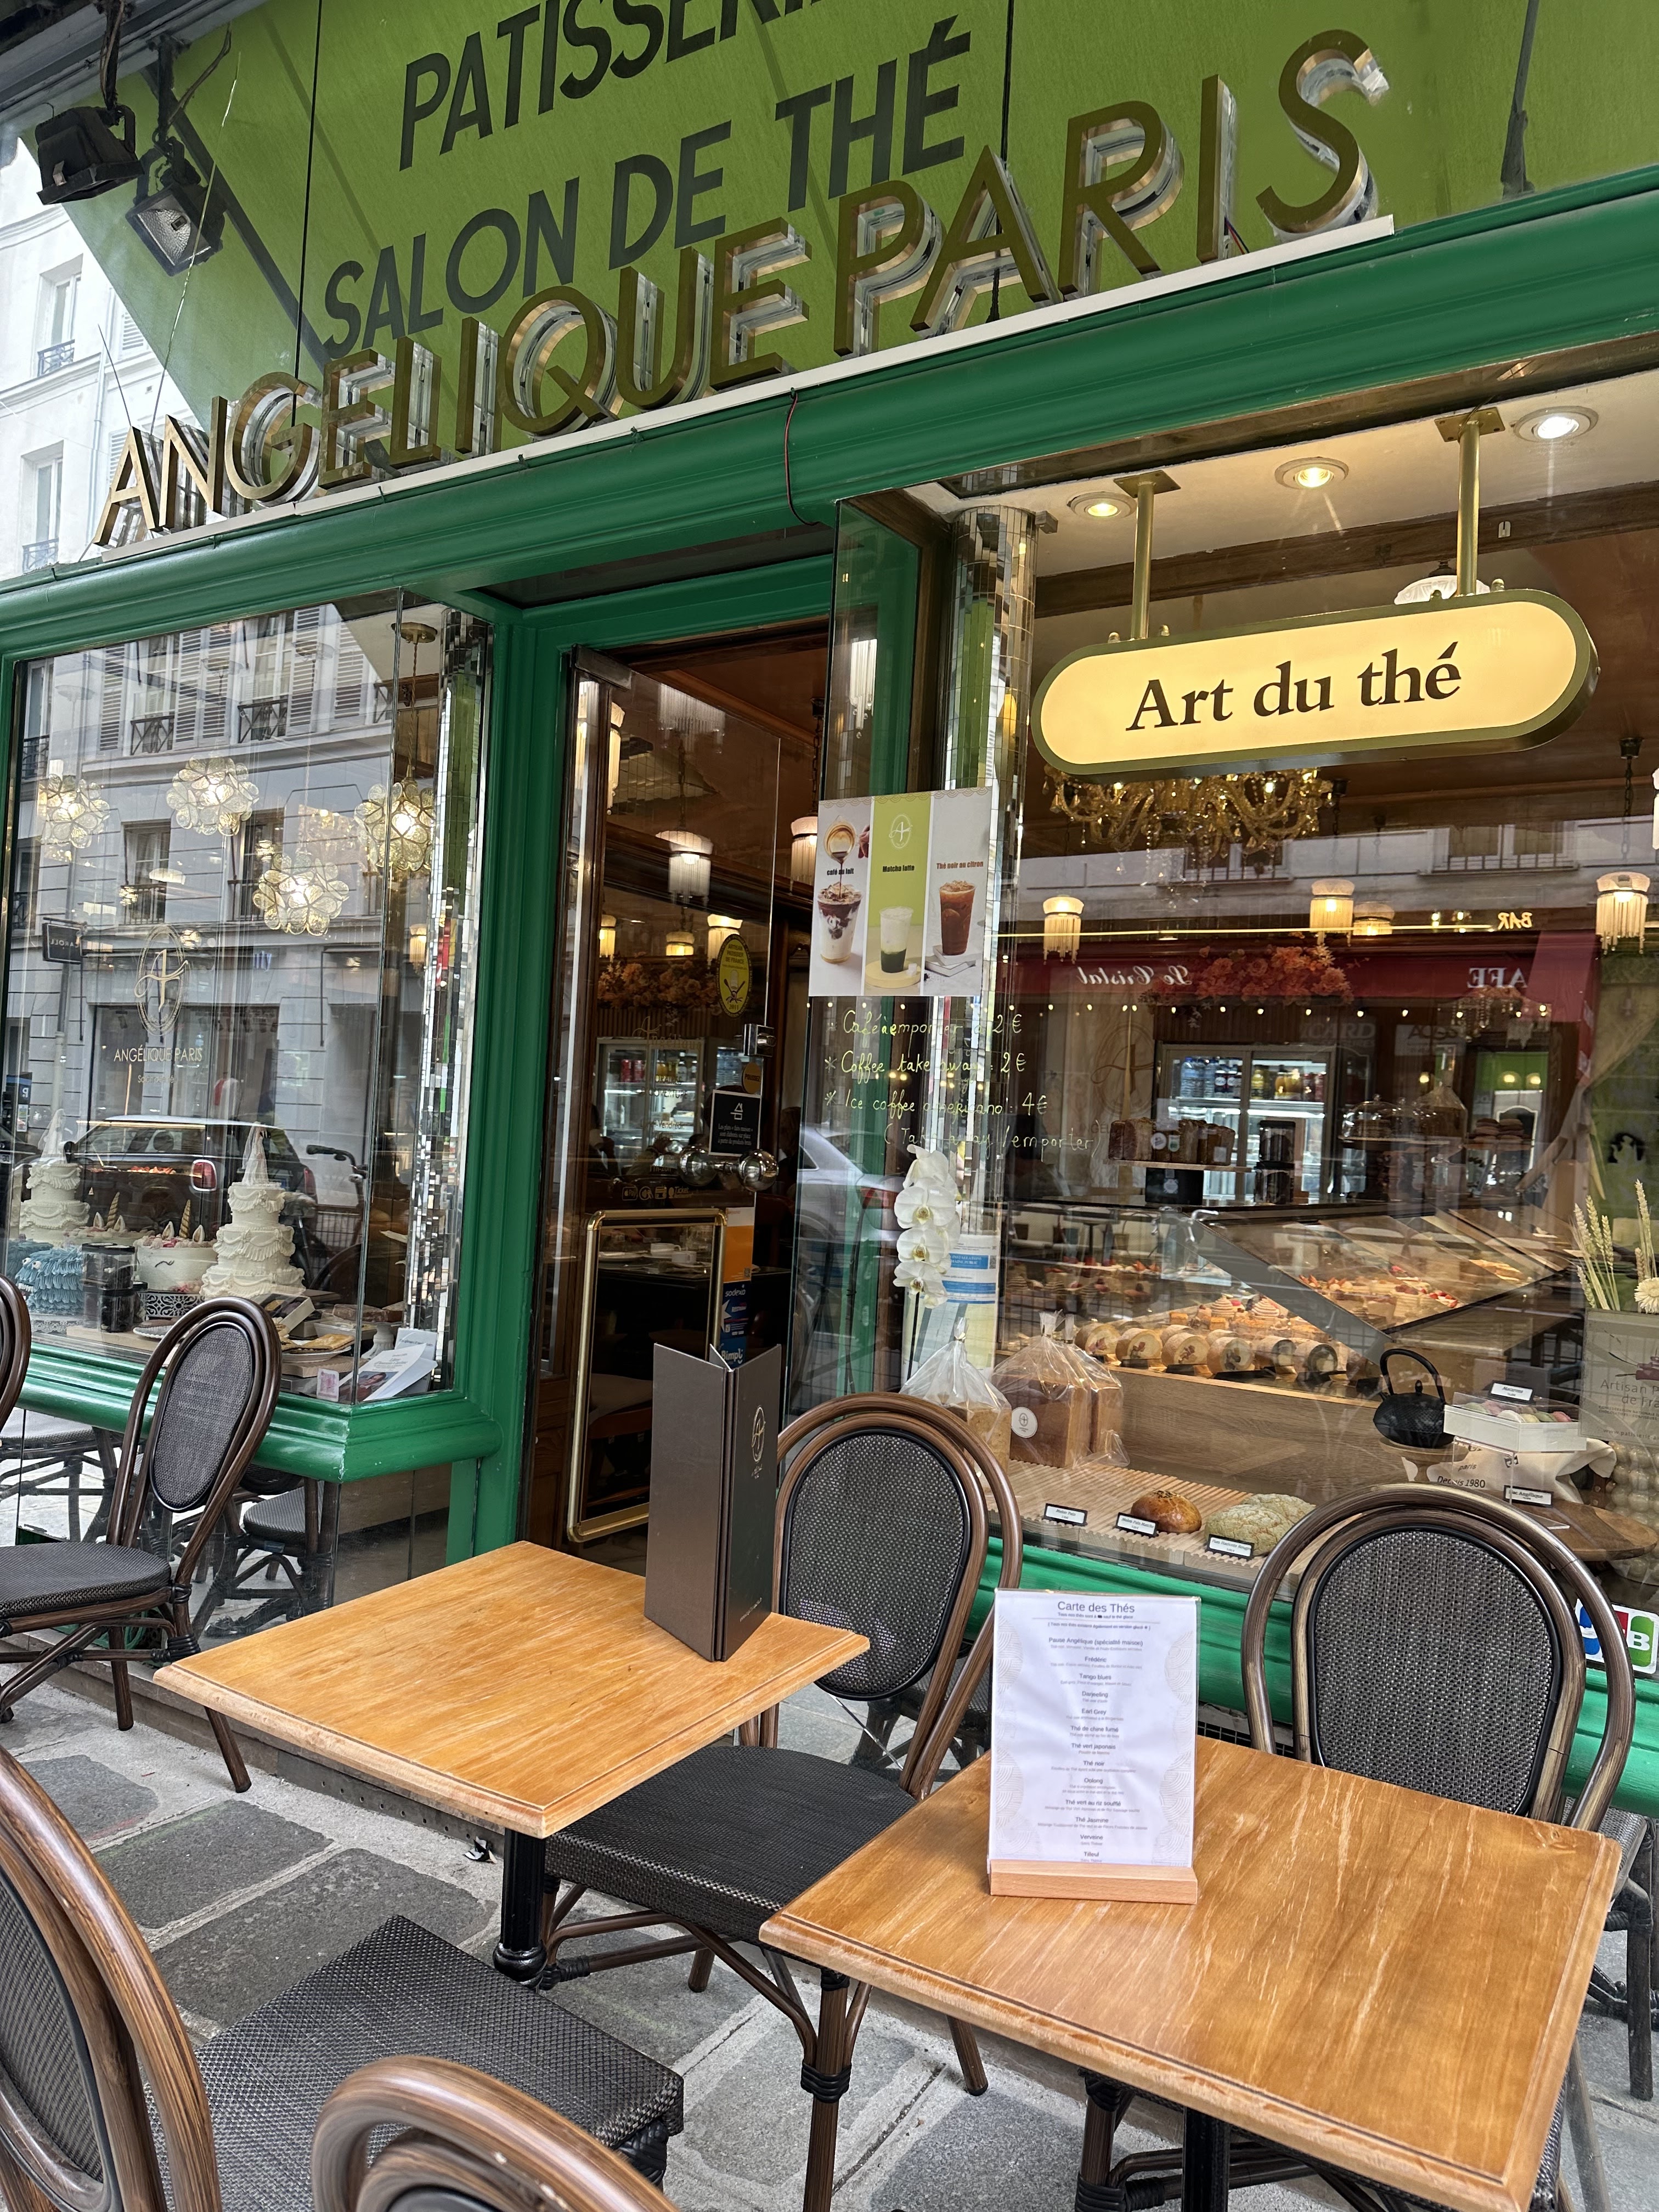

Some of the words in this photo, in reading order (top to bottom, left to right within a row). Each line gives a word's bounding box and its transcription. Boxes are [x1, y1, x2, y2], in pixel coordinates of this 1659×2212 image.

[324, 178, 579, 359] SALON
[608, 121, 731, 270] DE
[775, 15, 972, 212] THÉ
[94, 219, 812, 546] ANGELIQUE
[833, 29, 1388, 359] PARIS
[1125, 679, 1233, 731] Art
[1253, 660, 1334, 715] du
[1358, 641, 1462, 707] thé
[114, 1045, 172, 1062] ANGÉLIQUE
[174, 1047, 203, 1062] PARIS
[841, 1050, 884, 1084] Coffee
[897, 1053, 930, 1073] take
[845, 1088, 863, 1109] Ice
[873, 1089, 915, 1120] coffee
[1600, 1379, 1647, 1394] Artisan
[1621, 1393, 1637, 1405] de
[1458, 1463, 1477, 1472] paris
[1464, 1479, 1486, 1488] 1980
[1058, 1601, 1085, 1611] Carte
[1088, 1602, 1107, 1612] des
[1110, 1603, 1135, 1613] Thés
